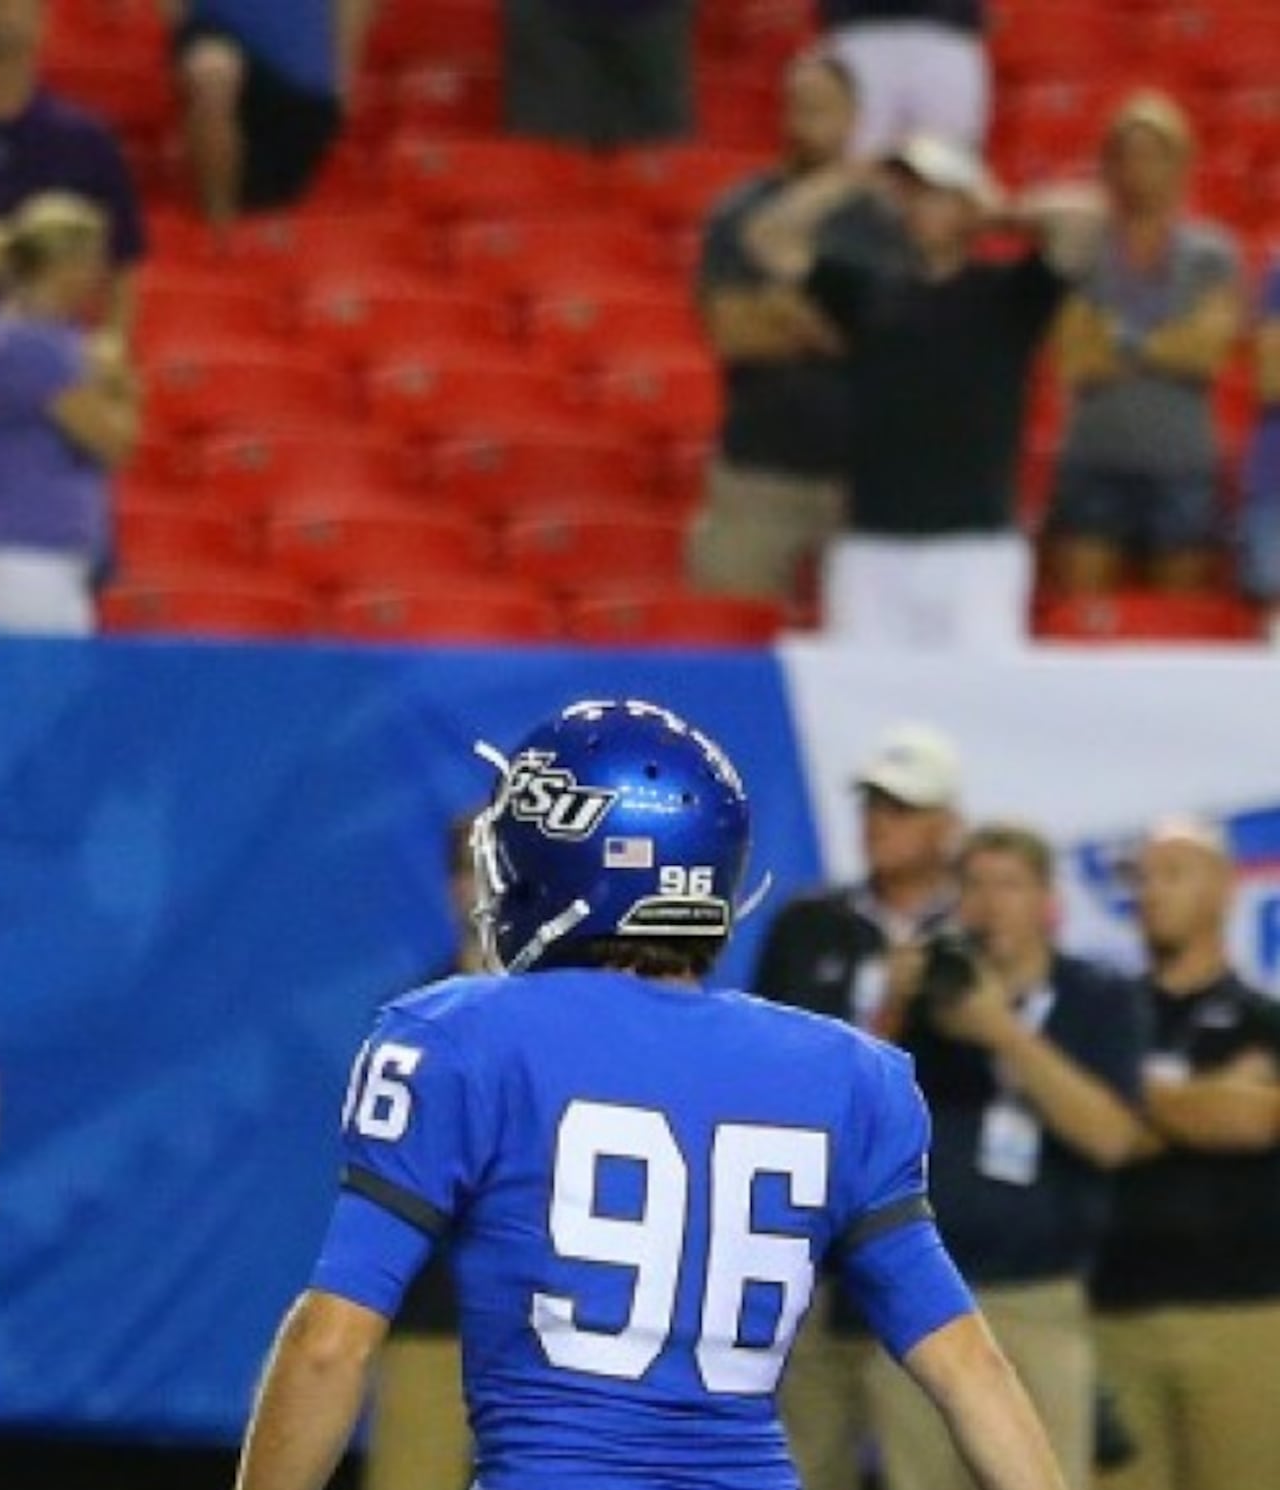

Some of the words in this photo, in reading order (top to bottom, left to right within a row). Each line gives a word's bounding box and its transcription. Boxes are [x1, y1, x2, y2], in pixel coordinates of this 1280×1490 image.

[660, 865, 715, 895] 96
[340, 1038, 424, 1141] 6
[532, 1099, 829, 1395] 96
